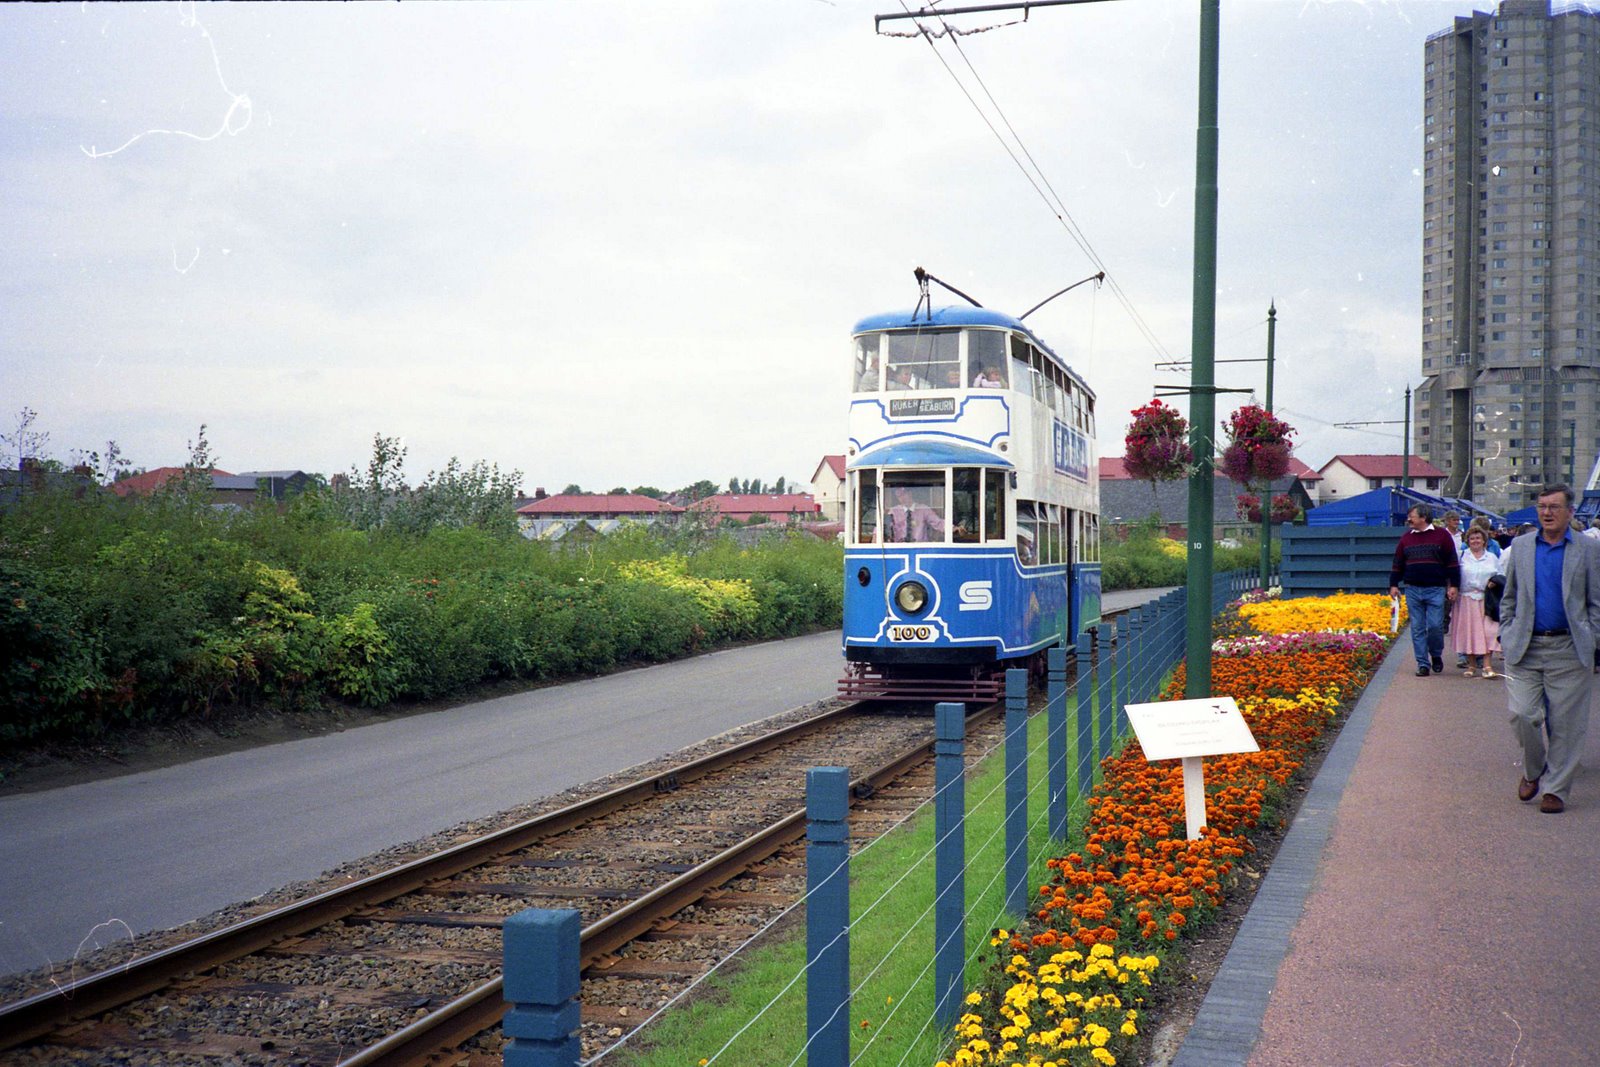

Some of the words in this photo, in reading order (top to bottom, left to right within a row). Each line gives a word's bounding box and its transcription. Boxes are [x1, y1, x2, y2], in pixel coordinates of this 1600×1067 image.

[919, 400, 954, 412] SEABURN
[1193, 542, 1202, 550] 10
[892, 626, 931, 641] 100
